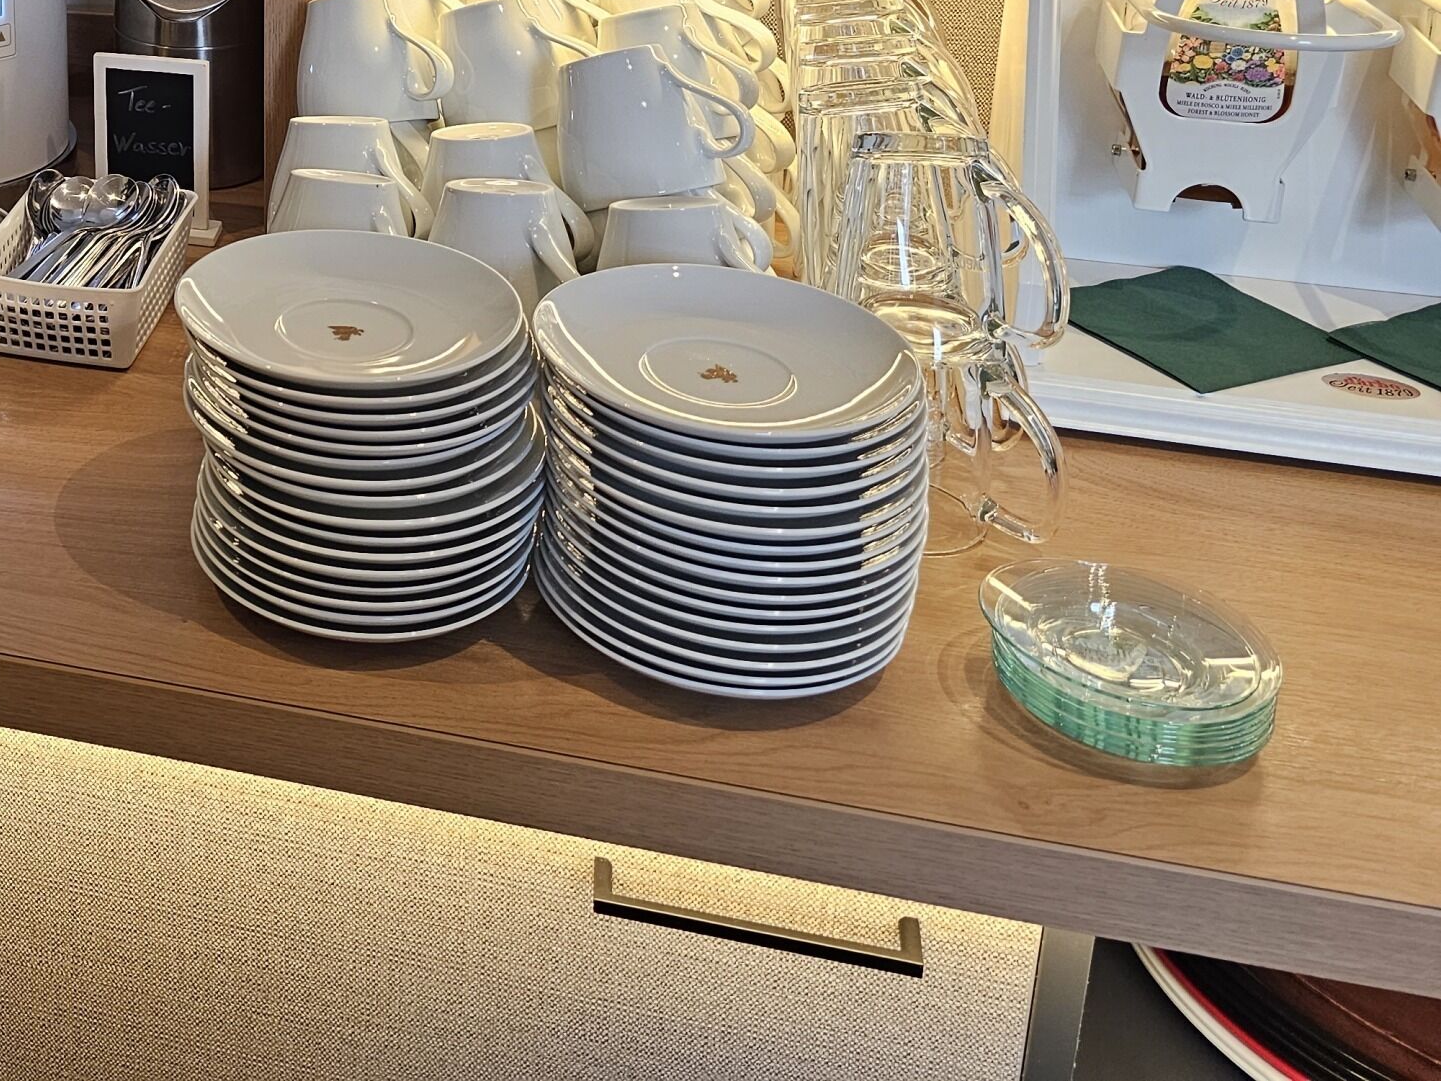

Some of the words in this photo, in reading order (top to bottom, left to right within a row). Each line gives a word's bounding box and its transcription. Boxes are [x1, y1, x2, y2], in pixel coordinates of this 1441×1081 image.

[1186, 92, 1207, 100] WALD-
[1216, 94, 1266, 103] BLÜTENHONIG
[113, 132, 192, 157] Wasser
[1329, 379, 1372, 394] Seit
[1377, 387, 1414, 398] 1879
